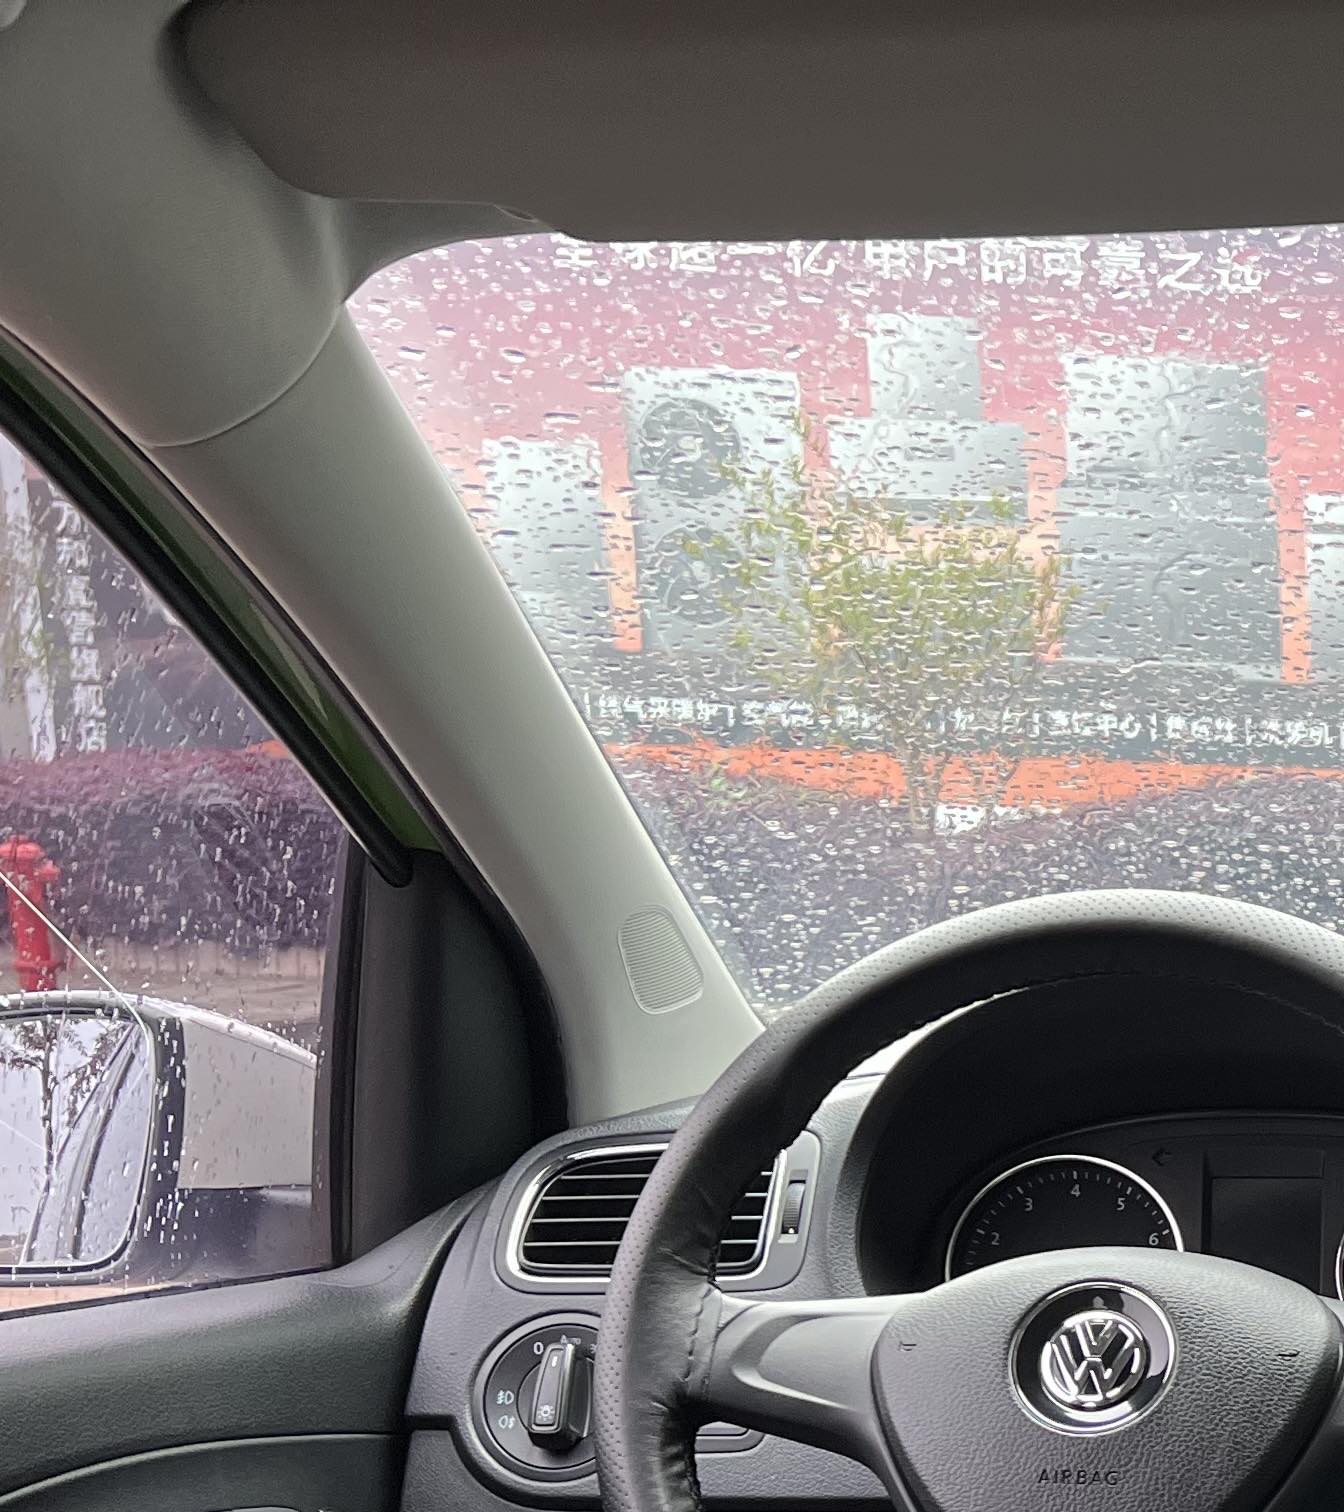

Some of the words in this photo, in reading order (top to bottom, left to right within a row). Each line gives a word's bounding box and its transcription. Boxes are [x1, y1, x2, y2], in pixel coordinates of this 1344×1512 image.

[48, 484, 107, 752] 万和直营旗舰店
[1070, 1184, 1081, 1198] 4
[1024, 1198, 1033, 1211] 3
[1116, 1197, 1126, 1211] 5
[991, 1232, 1000, 1245] 2
[1148, 1232, 1160, 1246] 6
[1038, 1468, 1119, 1486] AIRBAG
